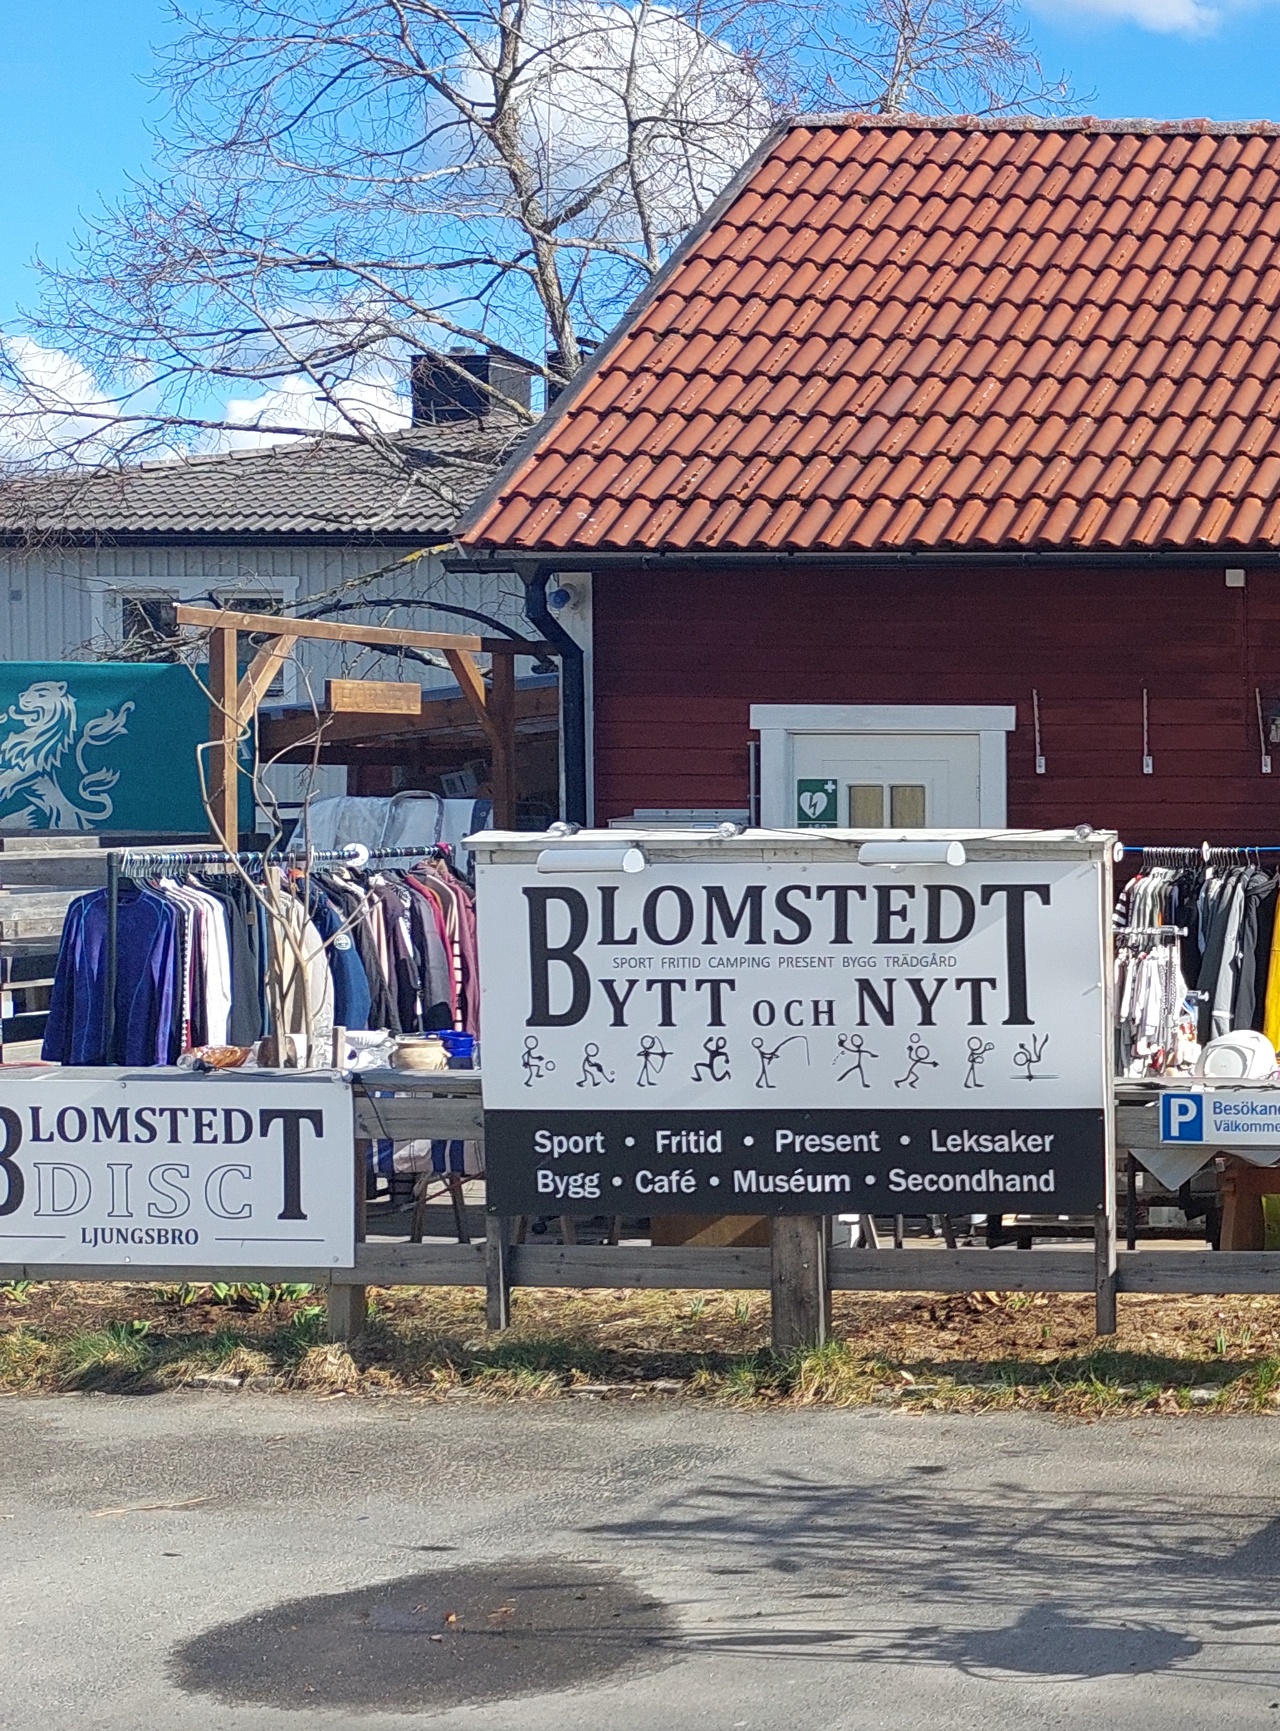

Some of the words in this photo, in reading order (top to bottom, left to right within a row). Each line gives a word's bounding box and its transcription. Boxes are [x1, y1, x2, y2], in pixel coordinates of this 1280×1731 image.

[522, 884, 1051, 1027] BLOMSTEDT
[612, 956, 655, 969] SPORT
[660, 956, 701, 969] FRITID
[708, 956, 771, 969] CAMPING
[778, 956, 836, 969] PRESENT
[842, 955, 877, 968] BYGG
[883, 952, 957, 968] TRÄDGÅRD
[752, 999, 836, 1027] OCH
[1170, 1097, 1198, 1136] P
[533, 1130, 606, 1156] Sport
[656, 1130, 722, 1153] Fritid
[775, 1130, 881, 1153] Present
[931, 1130, 1055, 1153] Leksaker
[32, 1162, 253, 1220] DISC
[536, 1169, 601, 1199] Bygg
[635, 1168, 697, 1194] Café
[733, 1168, 851, 1193] Muséum
[888, 1168, 1055, 1192] Secondhand
[81, 1227, 199, 1248] LJUNGSBRO
